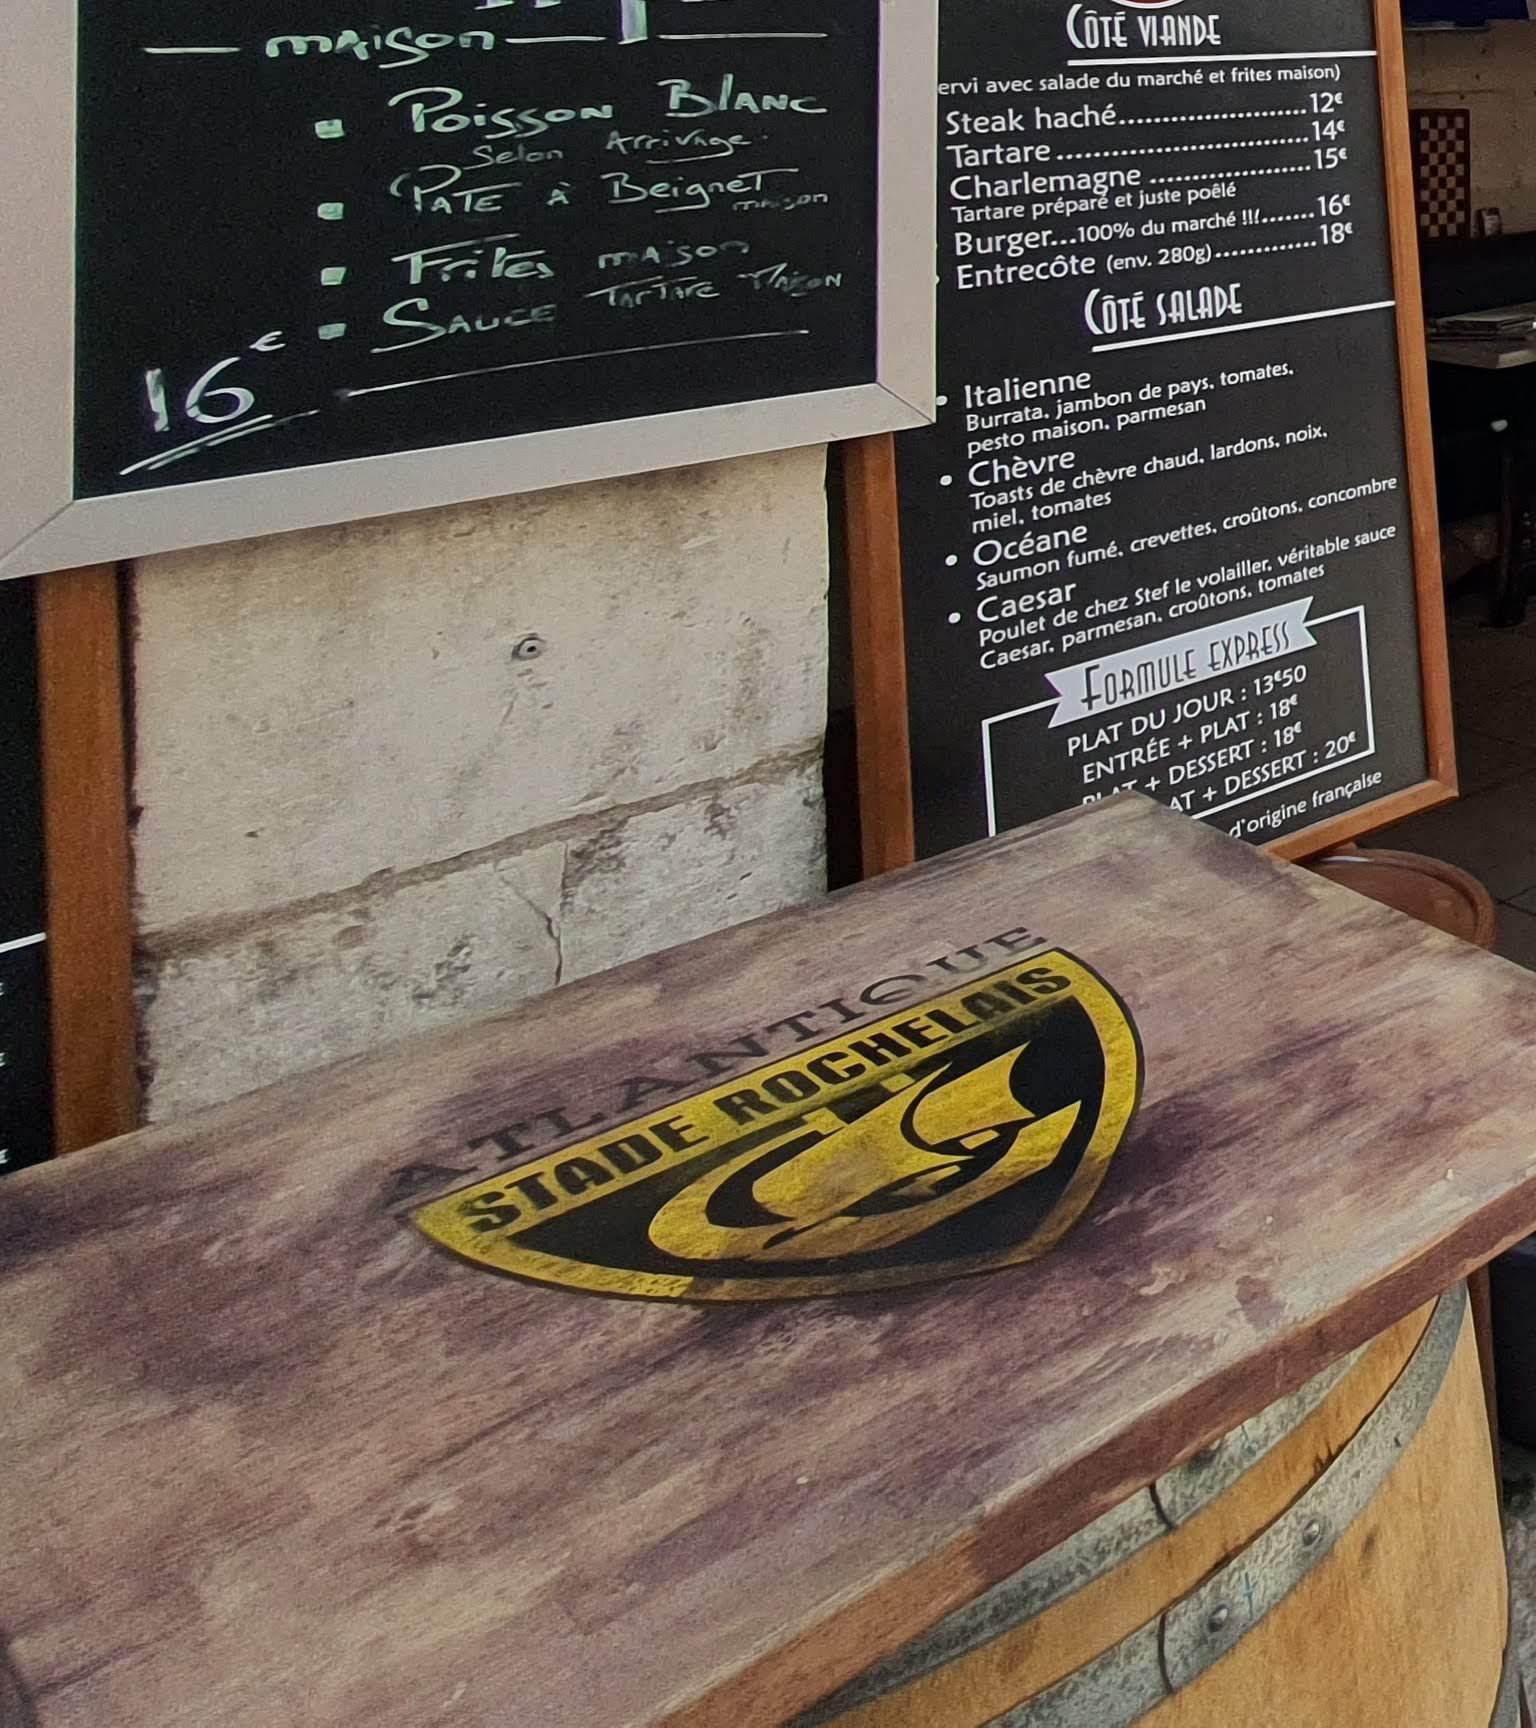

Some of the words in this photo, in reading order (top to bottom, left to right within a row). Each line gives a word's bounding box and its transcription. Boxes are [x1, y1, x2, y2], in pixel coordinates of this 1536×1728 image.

[937, 77, 979, 96] ervi
[986, 77, 1034, 94] avec
[1038, 71, 1100, 92] salade
[1106, 71, 1131, 89] du
[1137, 68, 1204, 87] marché
[1208, 68, 1225, 84] et
[1231, 65, 1272, 82] frites
[1277, 64, 1342, 83] maison)
[945, 104, 1025, 136] Steak
[462, 145, 564, 170] Selon
[946, 143, 1051, 169] Tartare
[949, 170, 1142, 201] Charlemagne
[950, 201, 1025, 224] Tartare
[1031, 192, 1109, 217] préparé
[1114, 193, 1133, 209] et
[1138, 187, 1181, 207] juste
[1187, 182, 1237, 205] poêlé
[1141, 219, 1165, 237] du
[1171, 211, 1236, 234] marché
[956, 253, 1096, 291] Entrecôte
[1106, 252, 1153, 274] (env.
[1158, 244, 1213, 268] 280g)
[963, 369, 1093, 409] Italienne
[1055, 387, 1133, 420] jambon
[1139, 381, 1164, 401] de
[967, 429, 1025, 459] pesto
[1116, 397, 1206, 432] parmesan
[967, 448, 1076, 488] Chèvre
[969, 485, 1034, 512] Toasts
[1040, 476, 1066, 497] de
[1074, 465, 1137, 490] chèvre
[1032, 490, 1113, 521] tomates
[973, 523, 1089, 568] Océane
[976, 558, 1061, 592] Saumon
[1308, 476, 1397, 509] concombre
[979, 617, 1048, 647] Poulet
[1053, 608, 1079, 628] de
[1084, 596, 1129, 621] chez
[1134, 580, 1170, 606] Stef
[1175, 577, 1193, 595] le
[1278, 538, 1349, 568] véritable
[1354, 525, 1397, 549] sauce
[1258, 563, 1326, 593] tomates
[977, 580, 1077, 624] Caesar
[1066, 723, 1123, 758] PLAT
[1131, 709, 1168, 736] DU
[1172, 688, 1235, 726] JOUR
[1081, 734, 1171, 784] ENTRÉE
[1200, 710, 1251, 745] PLAT
[1168, 739, 1254, 786] DESSERT
[1225, 750, 1307, 797] DESSERT
[1228, 799, 1307, 840] d'origine
[1311, 770, 1383, 810] française
[384, 926, 1052, 1203] ATLANTIQUE
[458, 1115, 718, 1236] STADE
[710, 965, 1074, 1128] ROCHELAIS
